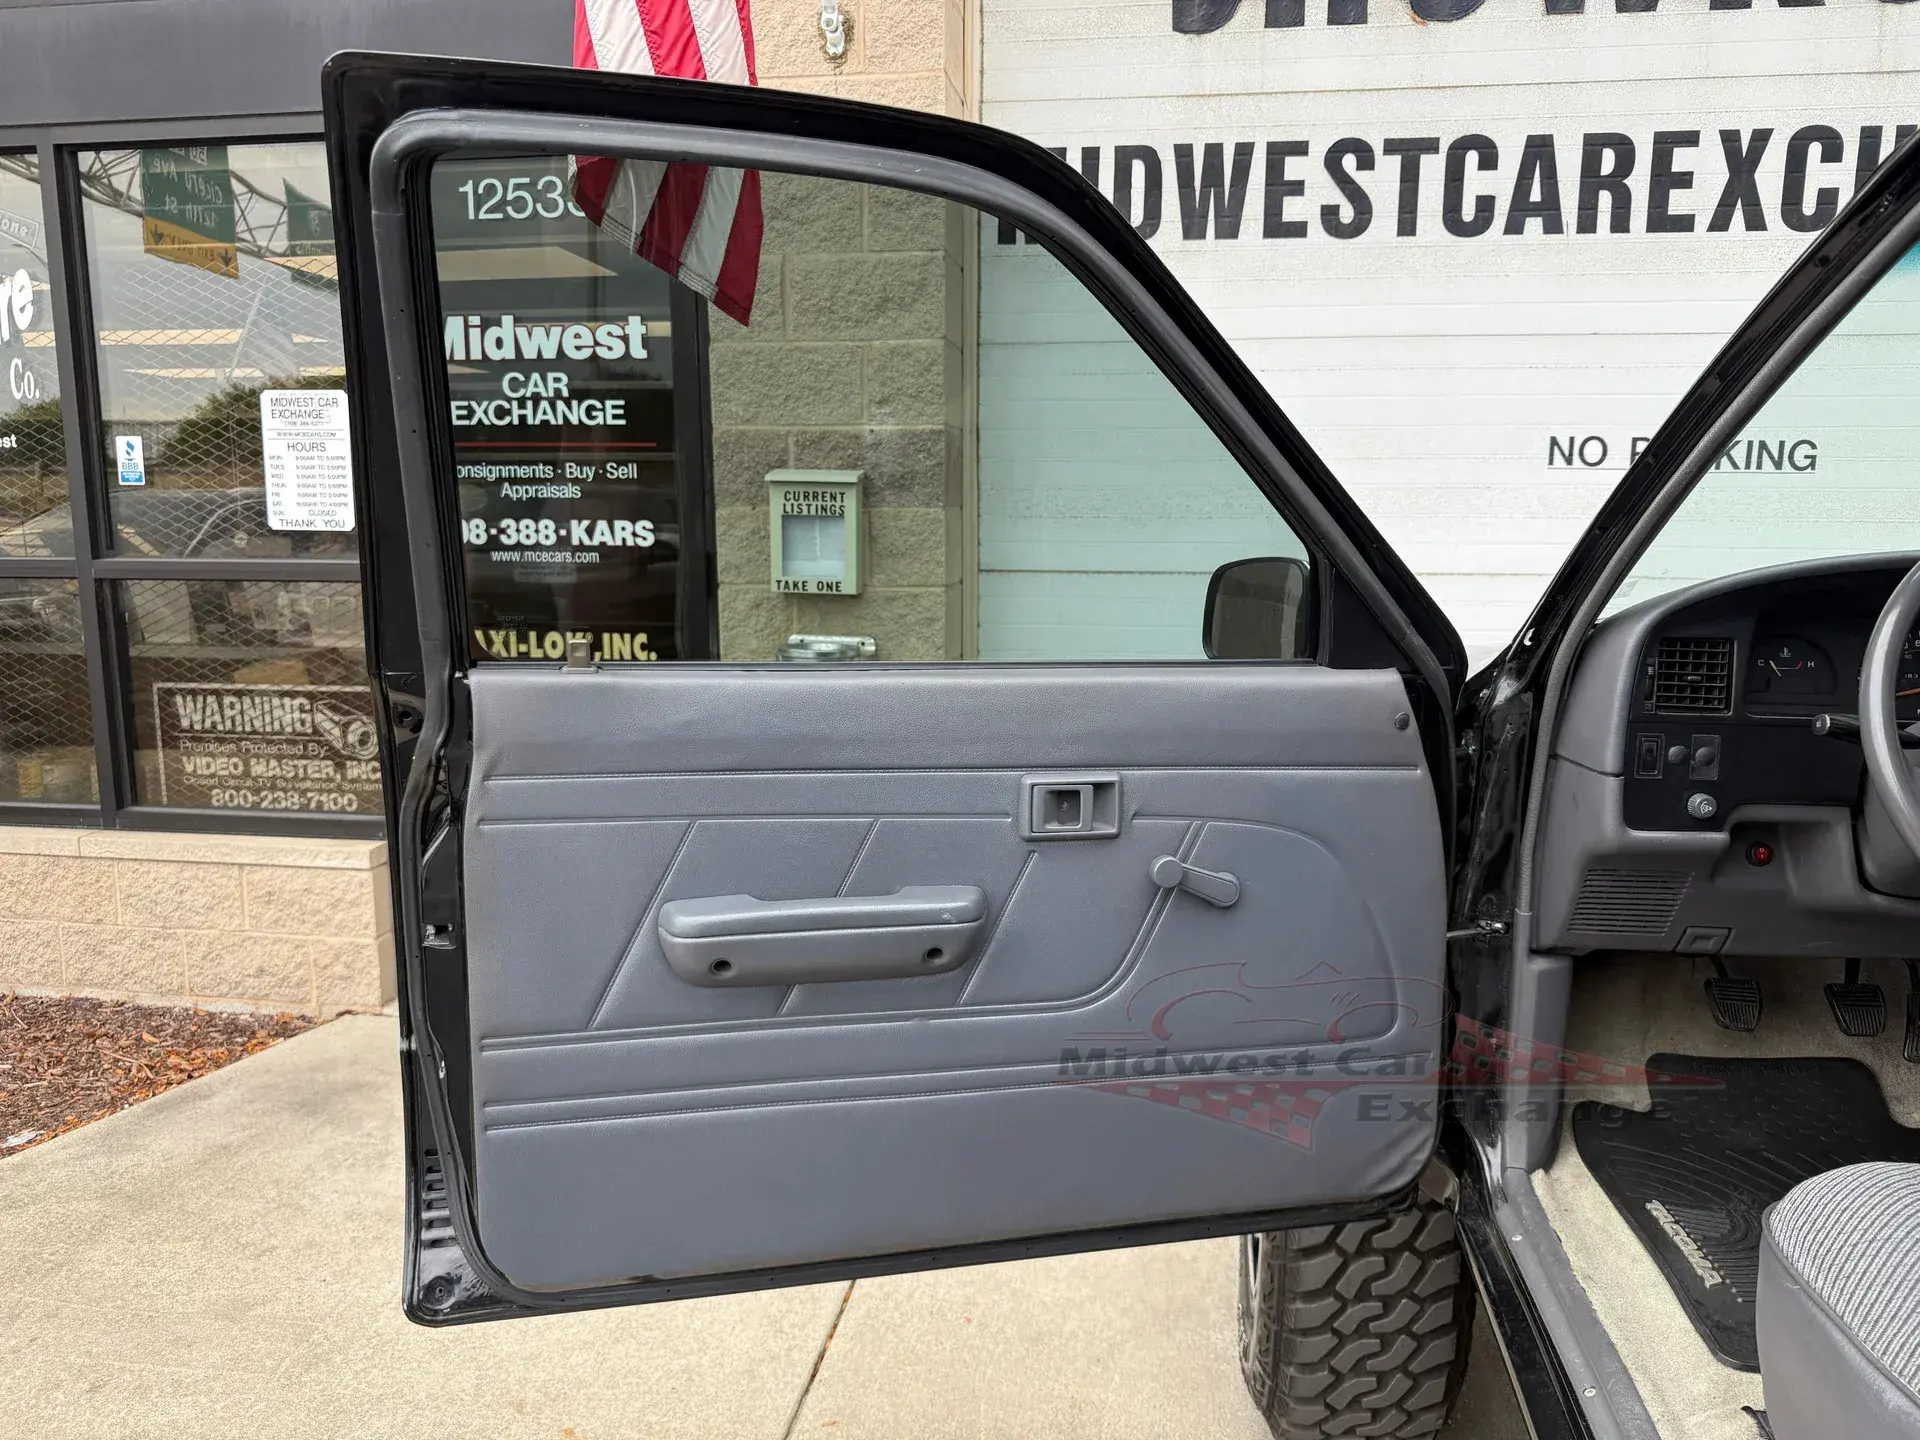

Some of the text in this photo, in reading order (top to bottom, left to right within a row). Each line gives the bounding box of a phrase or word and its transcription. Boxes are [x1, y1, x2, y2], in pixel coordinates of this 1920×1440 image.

[459, 176, 586, 220] 1253
[10, 357, 40, 400] Co.
[502, 372, 569, 398] CAR
[270, 397, 339, 408] MIDWEST CAR
[271, 409, 324, 420] EXCHANGE
[451, 400, 626, 426] EXCHANGE
[287, 442, 326, 453] HOURS
[1549, 435, 1818, 472] NO PKING
[122, 462, 139, 470] BBB
[457, 462, 638, 482] onsignments Buy Sell
[501, 482, 582, 501] Appraisals
[784, 491, 846, 503] CURRENT
[308, 509, 337, 517] CLOSED
[783, 503, 846, 516] LISTINGS
[279, 519, 346, 529] THANK YOU
[491, 550, 600, 563] www.mcecars.com
[775, 580, 843, 592] TAKE ONE
[175, 694, 313, 733] WARNING
[180, 740, 237, 753] Premises
[242, 741, 303, 755] Protected
[181, 756, 245, 776] VIDEO
[250, 759, 342, 782] MASTER,
[184, 775, 219, 786] Closed
[258, 779, 272, 788] TV
[1645, 1199, 1723, 1290] TACOMA
